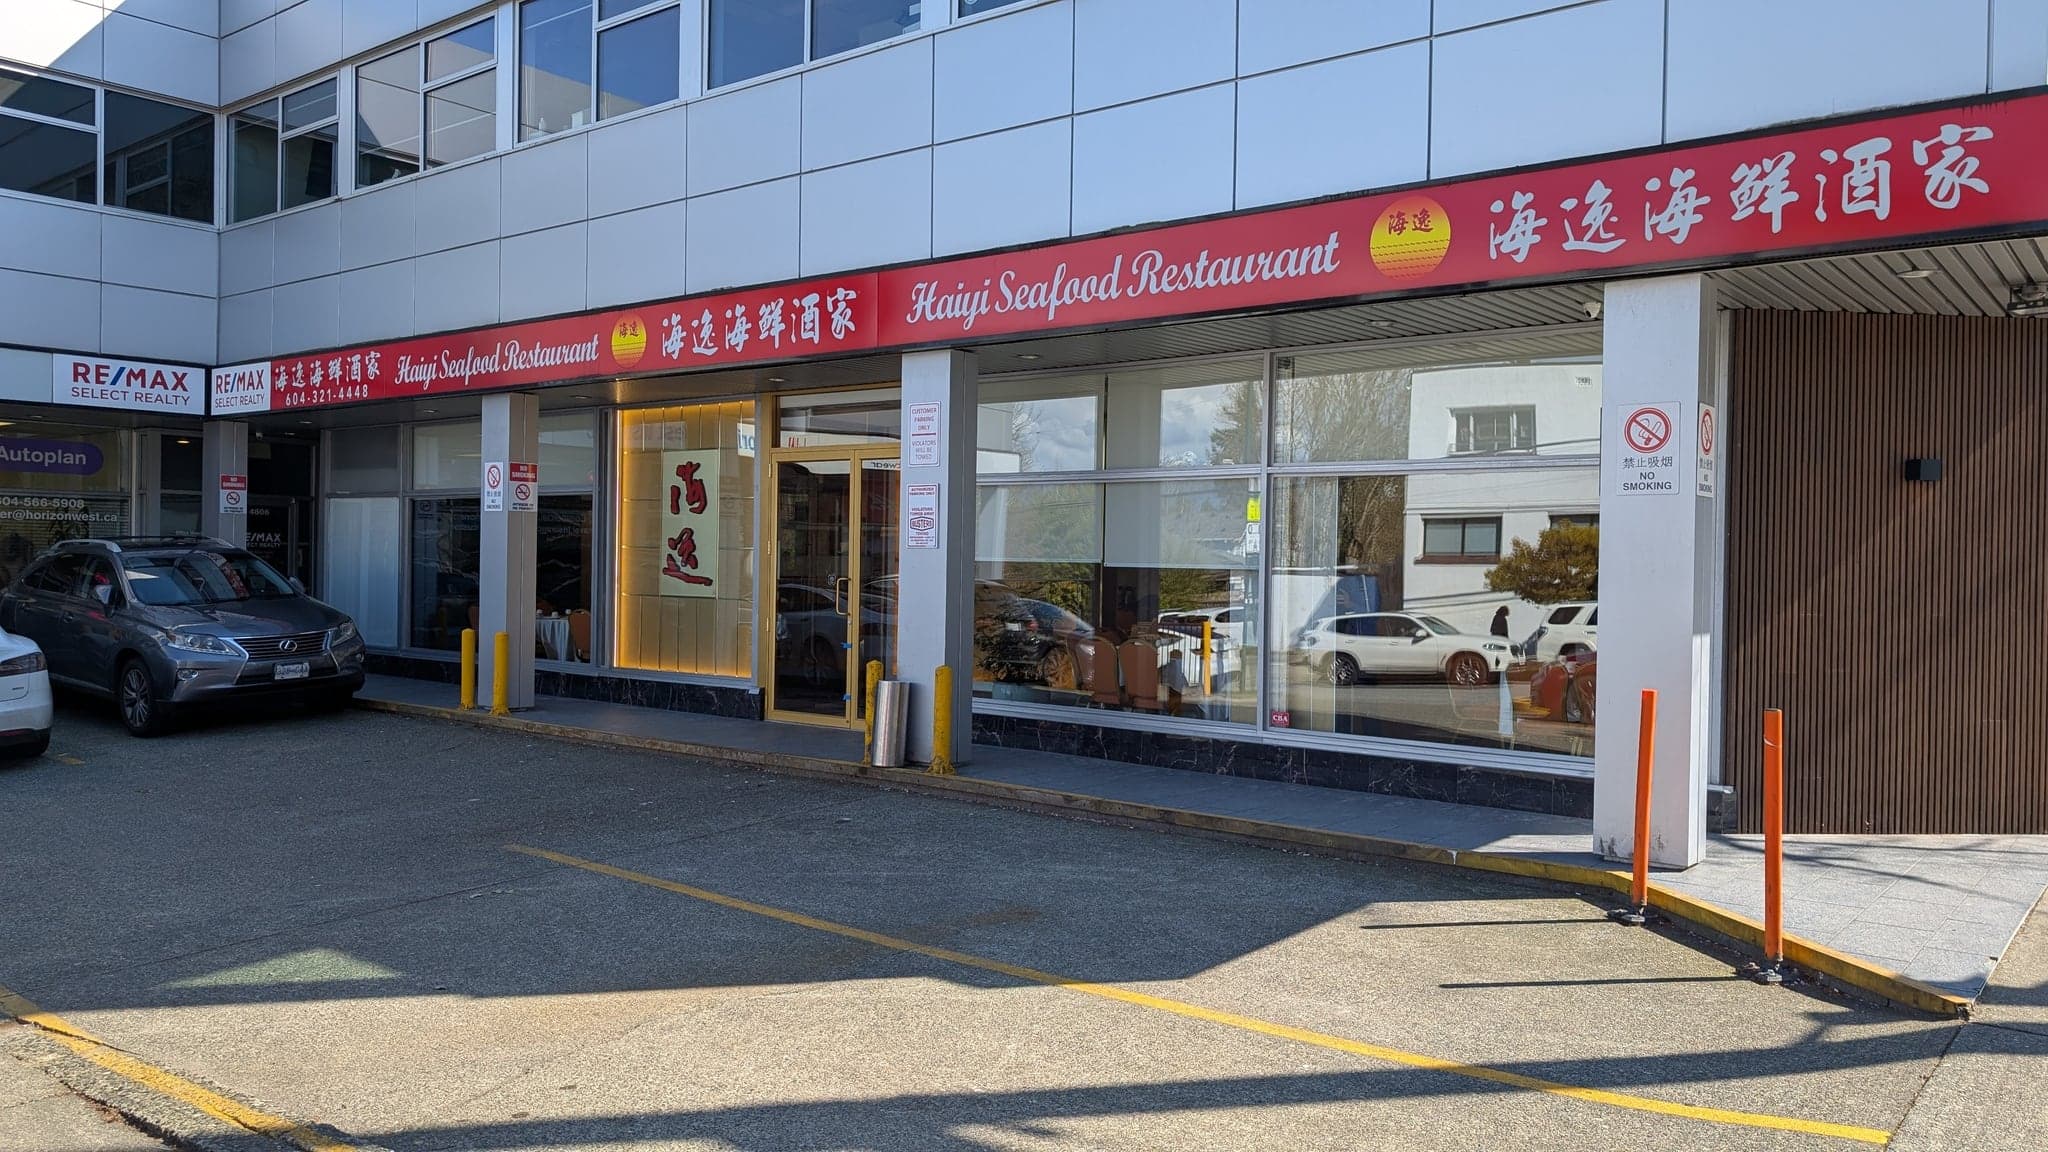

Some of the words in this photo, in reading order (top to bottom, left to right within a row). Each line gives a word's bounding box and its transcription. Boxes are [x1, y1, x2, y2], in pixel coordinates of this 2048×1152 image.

[1488, 123, 1994, 263] 海逸海鮮酒家
[1388, 209, 1435, 237] 海逸
[906, 281, 991, 331] Haiyi
[994, 254, 1123, 321] Seafood
[1127, 230, 1341, 298] Restaurant
[662, 287, 856, 360] 海逸海鮮酒家
[394, 354, 440, 390] Haiyi
[440, 342, 500, 386] Seafood
[502, 333, 600, 372] Restaurant
[72, 362, 188, 392] RE/MAX
[215, 369, 264, 394] RE/MAX
[71, 386, 129, 401] SELECT
[135, 391, 190, 405] REALTY
[215, 397, 238, 408] SELECT
[240, 393, 265, 406] REALTY
[285, 385, 368, 406] 604-321-4448
[0, 445, 86, 467] Autoplan
[1622, 456, 1673, 469] 禁止吸烟
[1623, 482, 1672, 491] SMOKING
[1640, 472, 1655, 480] NO
[0, 496, 85, 509] 04-566-5908
[246, 532, 280, 542] E/MAX
